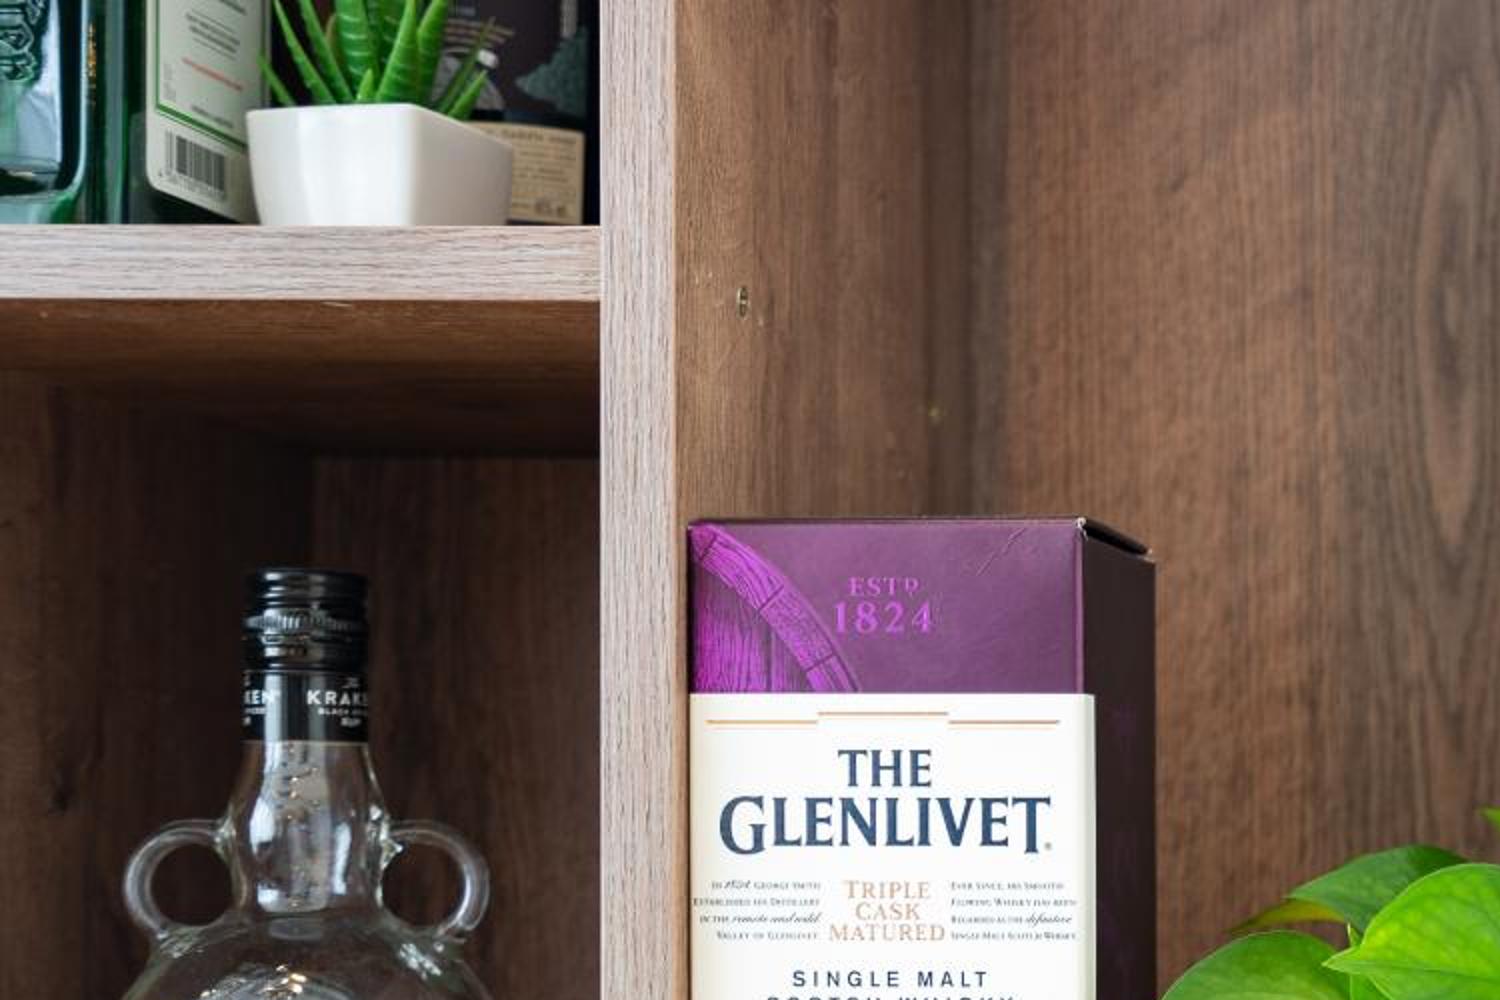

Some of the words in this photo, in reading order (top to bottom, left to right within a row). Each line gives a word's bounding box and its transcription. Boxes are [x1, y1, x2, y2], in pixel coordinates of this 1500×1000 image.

[834, 601, 934, 634] 1824
[837, 749, 933, 787] THE
[718, 795, 1051, 855] GLENLIVET
[844, 880, 930, 899] TRIPLE
[856, 901, 920, 921] CASK
[830, 923, 945, 941] MATURED
[793, 970, 900, 988] SINGLE
[917, 970, 987, 988] MALT
